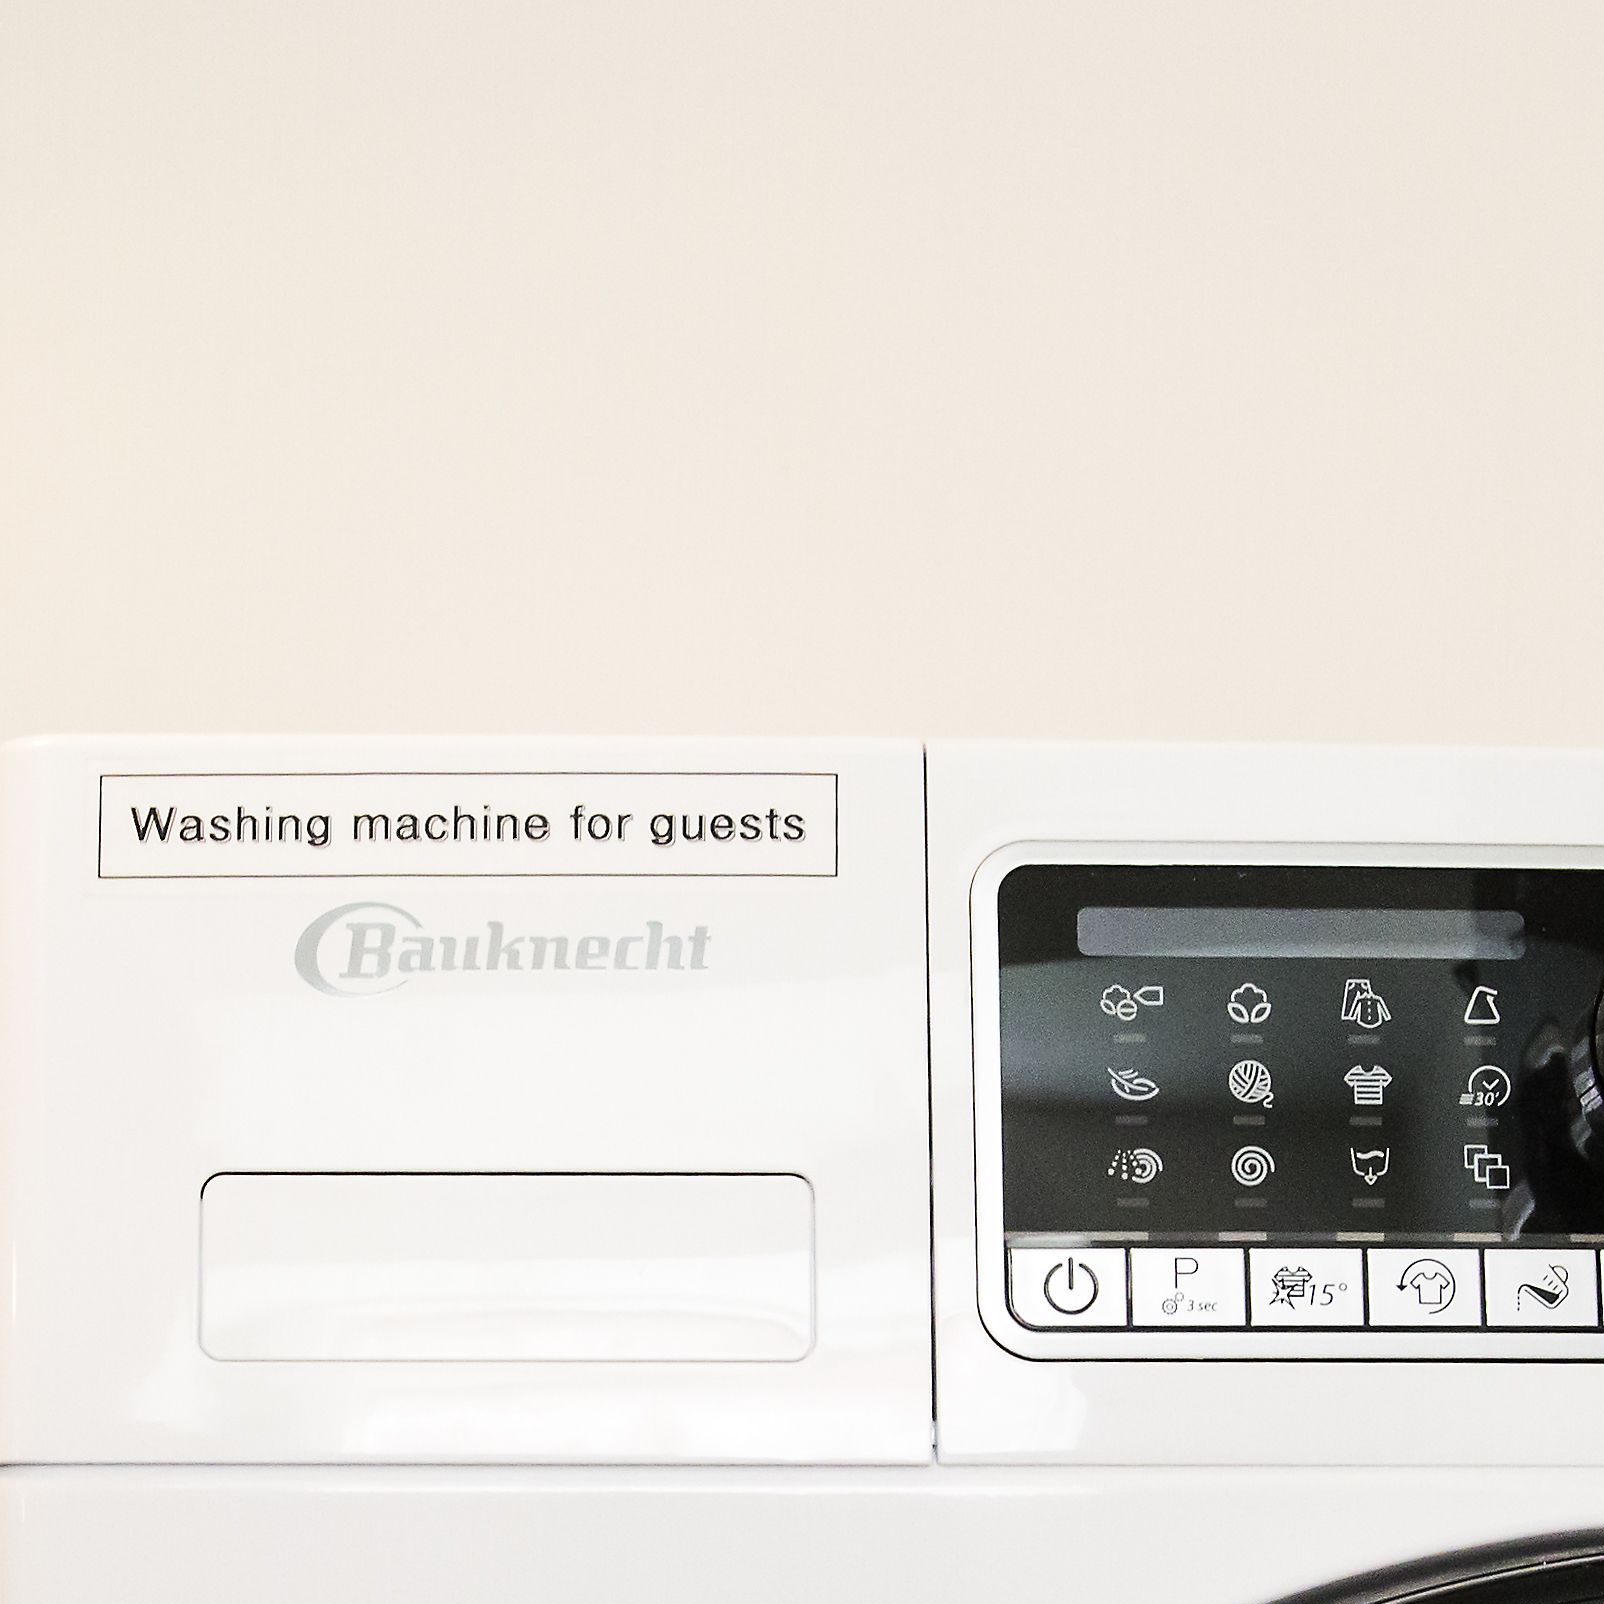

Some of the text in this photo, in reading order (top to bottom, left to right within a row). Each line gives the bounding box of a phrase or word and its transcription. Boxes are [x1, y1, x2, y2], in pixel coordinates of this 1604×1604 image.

[131, 804, 808, 848] Washing machine for guests
[325, 918, 712, 981] Bauknecht
[1174, 1257, 1199, 1289] P
[1187, 1300, 1218, 1312] 3 sec
[1309, 1282, 1348, 1306] 15°
